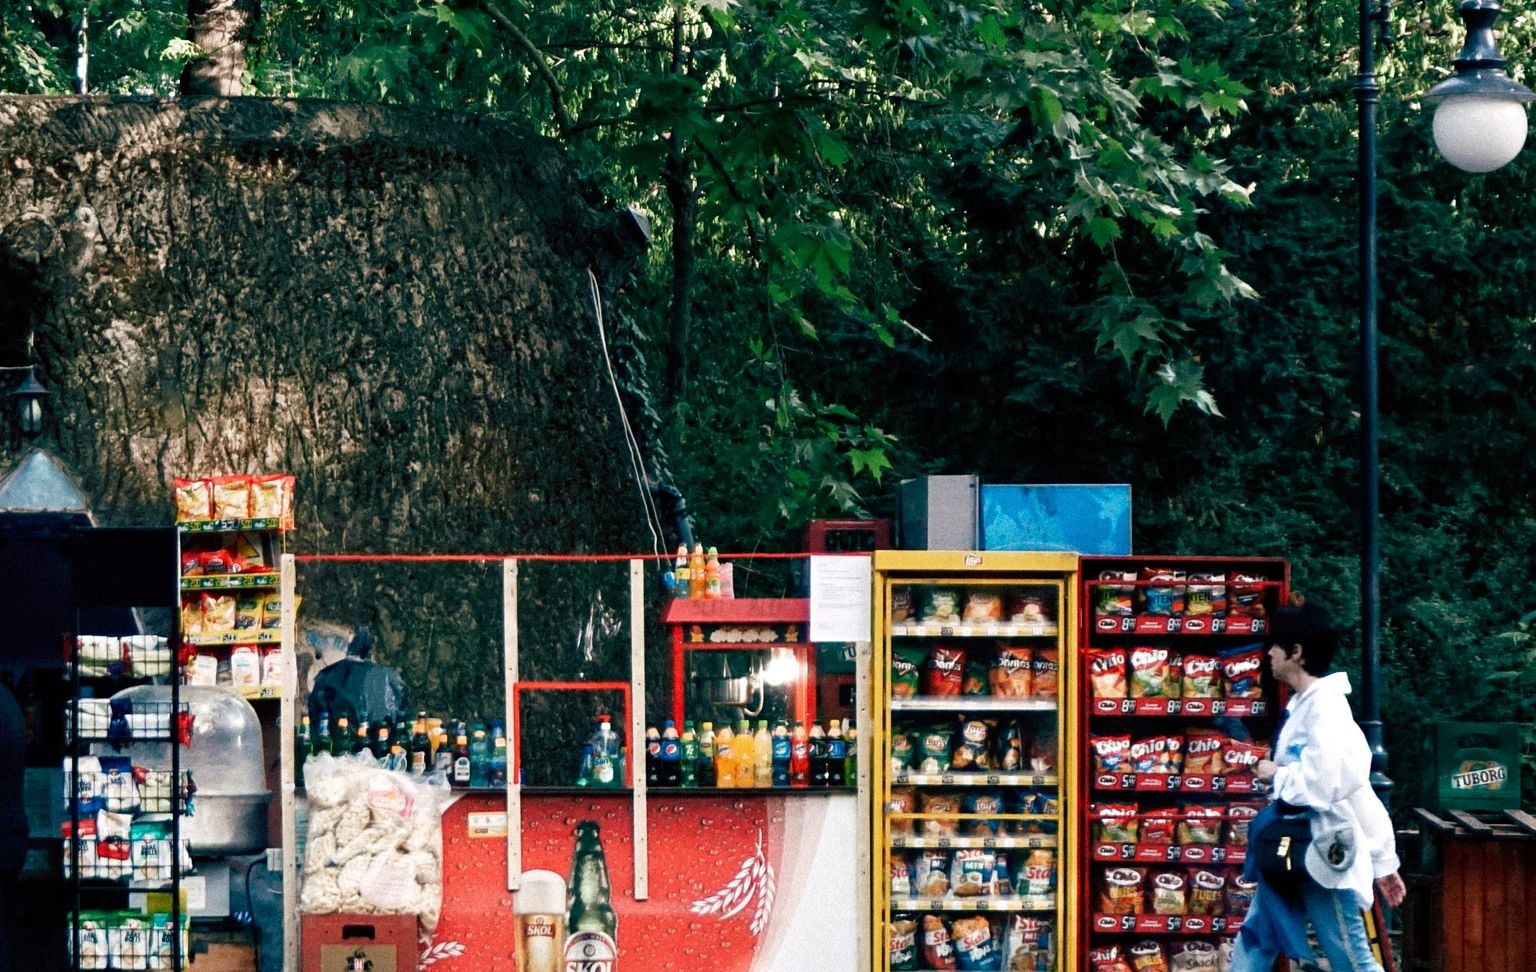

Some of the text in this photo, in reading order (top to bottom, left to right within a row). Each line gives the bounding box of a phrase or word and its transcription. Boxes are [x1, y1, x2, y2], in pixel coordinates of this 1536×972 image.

[1093, 654, 1125, 672] Chio
[1131, 650, 1168, 668] Chio
[1188, 659, 1222, 675] Chio
[1225, 658, 1261, 677] Chio
[1096, 740, 1130, 755] Chio
[1131, 740, 1165, 758] Chio
[1189, 738, 1221, 753] Chio
[1224, 750, 1259, 764] Chio
[1453, 768, 1506, 787] TUBORG
[1112, 870, 1140, 882] Chio
[527, 925, 553, 936] SKOL
